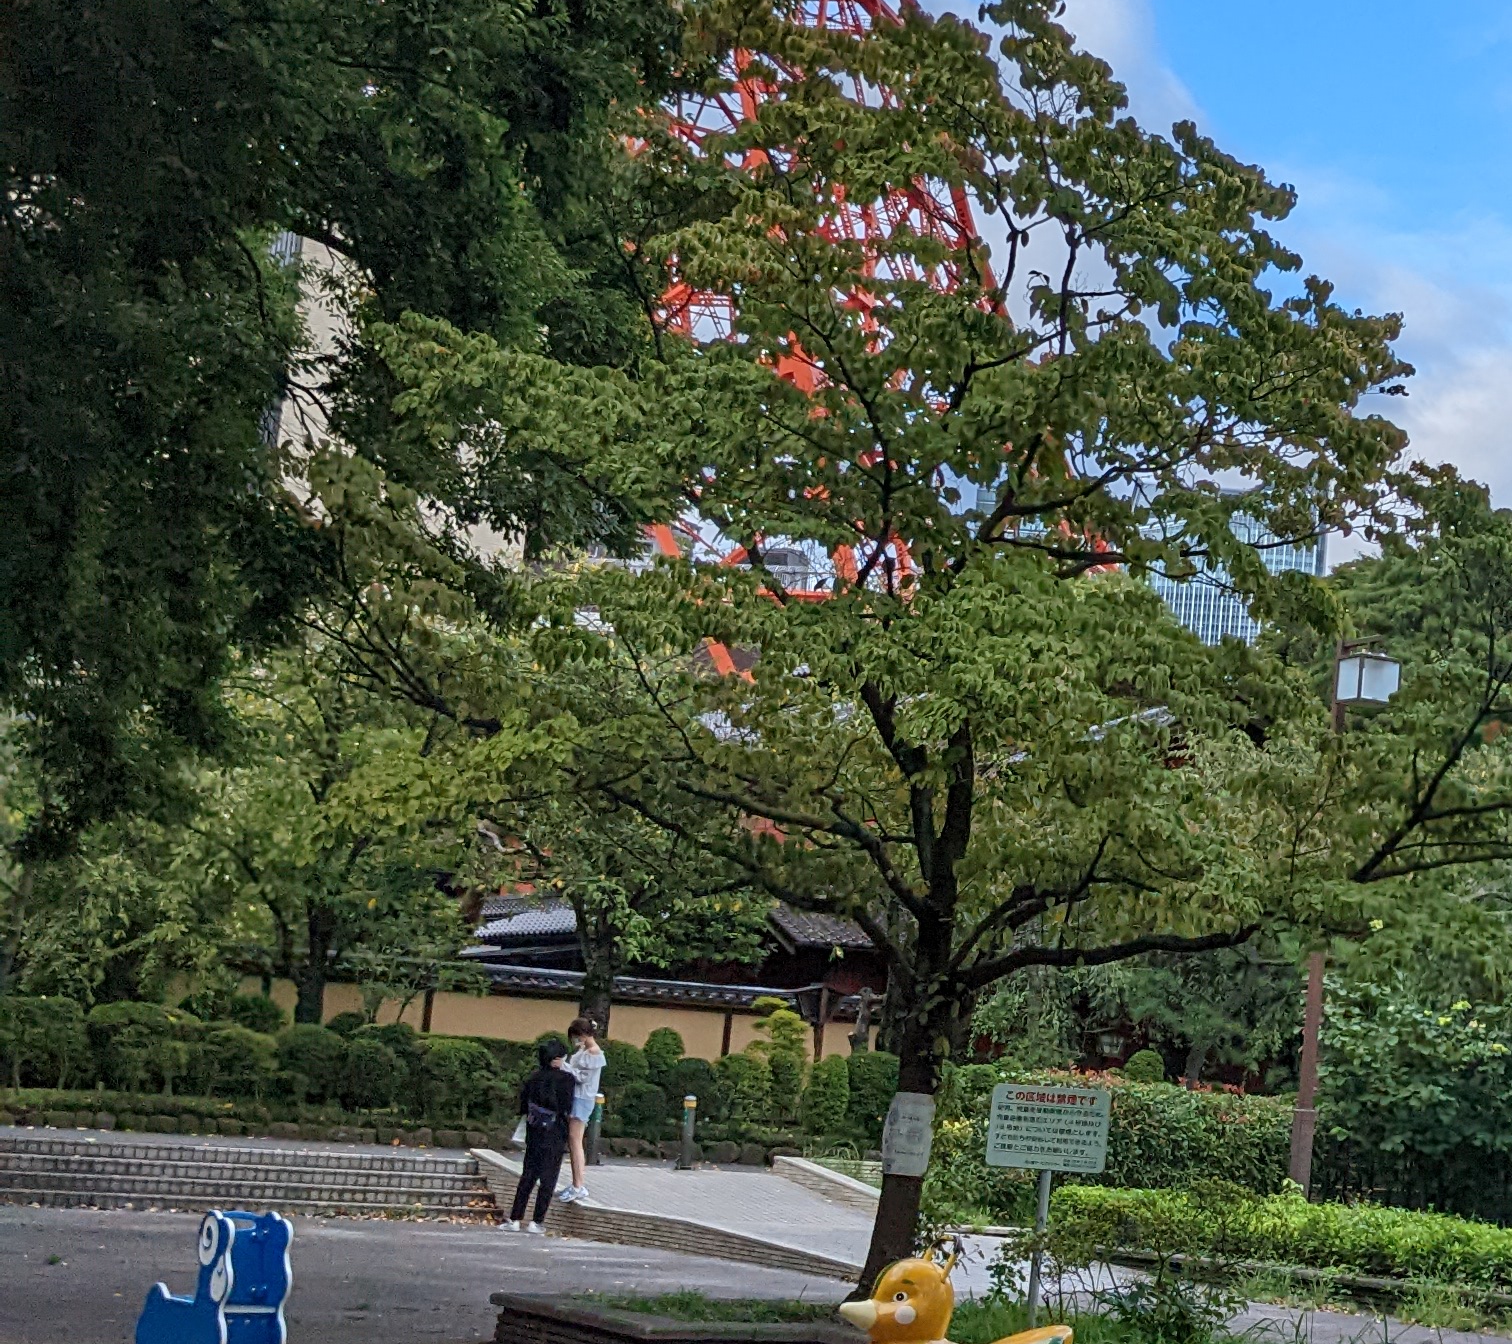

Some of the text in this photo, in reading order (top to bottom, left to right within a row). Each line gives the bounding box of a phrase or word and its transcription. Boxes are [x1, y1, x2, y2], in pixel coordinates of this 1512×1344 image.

[1005, 1090, 1098, 1106] この区域は禁煙です
